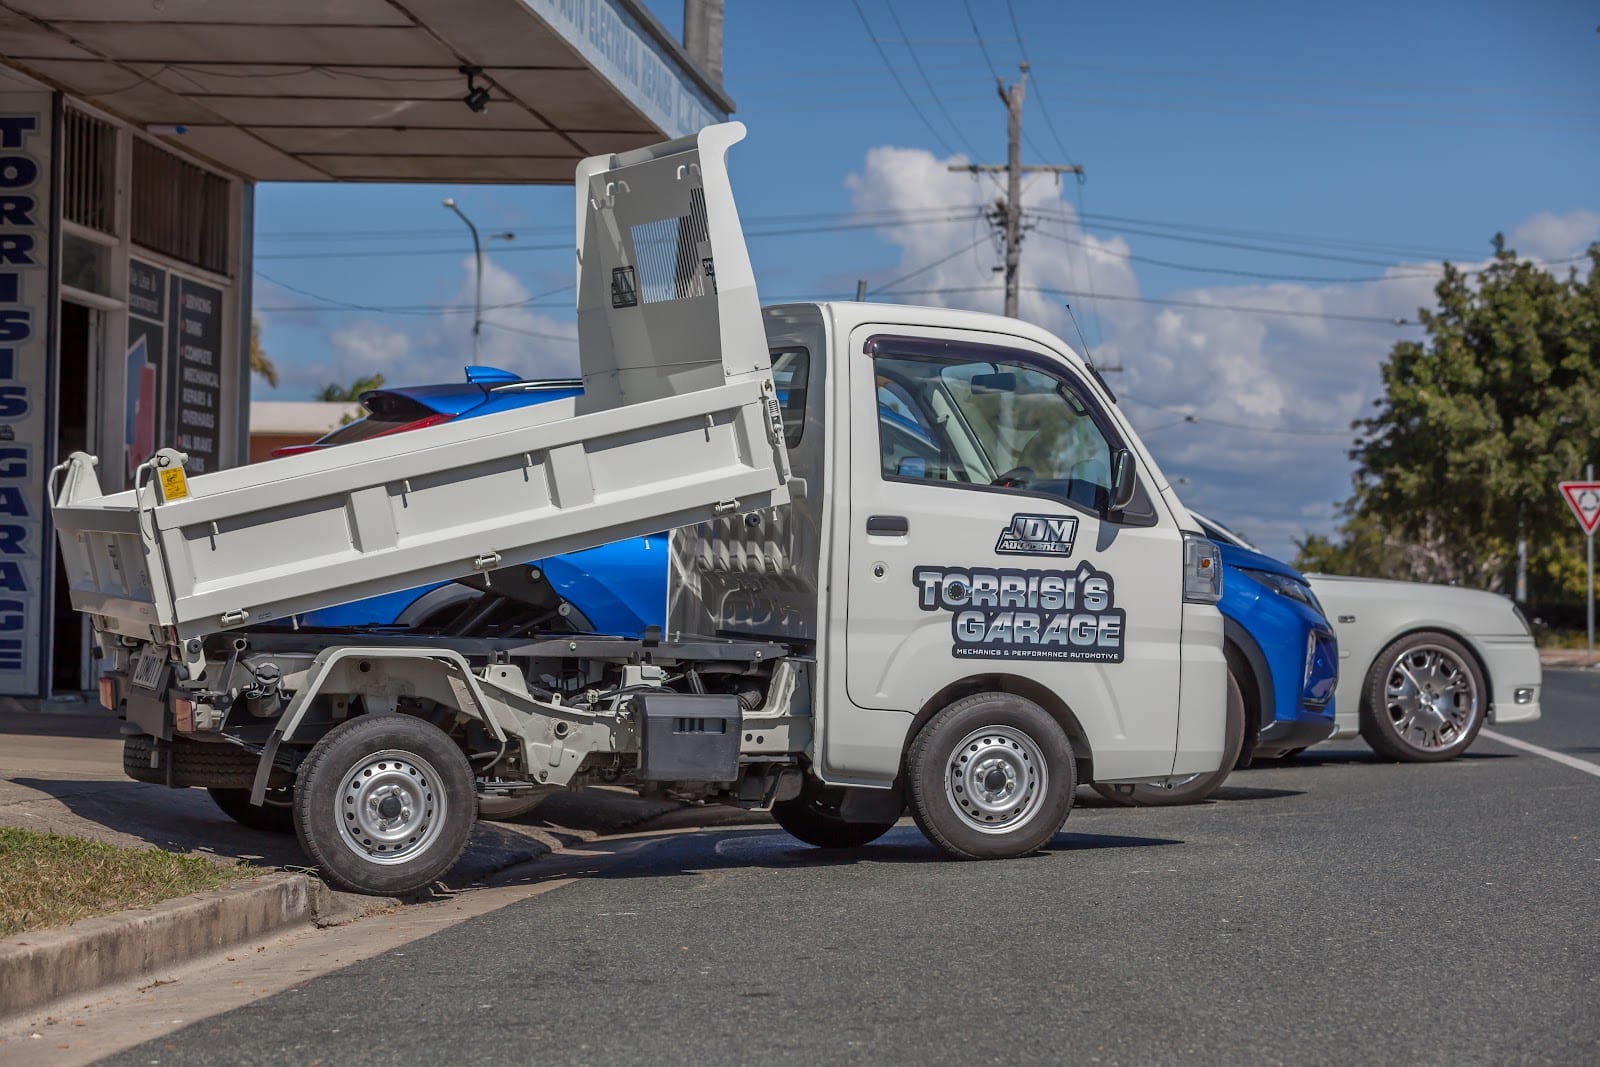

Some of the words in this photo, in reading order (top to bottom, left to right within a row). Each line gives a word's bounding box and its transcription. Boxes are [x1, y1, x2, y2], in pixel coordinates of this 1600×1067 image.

[589, 0, 639, 88] ELECTRICAL
[641, 46, 672, 118] REPAIRS
[184, 345, 212, 366] COMPLETE
[183, 367, 219, 388] MECHANICAL
[1004, 519, 1074, 541] JDM
[1001, 540, 1072, 552] Autocenter
[919, 567, 1109, 611] TORRISI'S
[957, 611, 1121, 647] GARAGE
[957, 648, 1001, 656] MECHANICS
[1012, 650, 1068, 658] PERFORMANCE
[1070, 651, 1118, 660] AUTOMOTIVE
